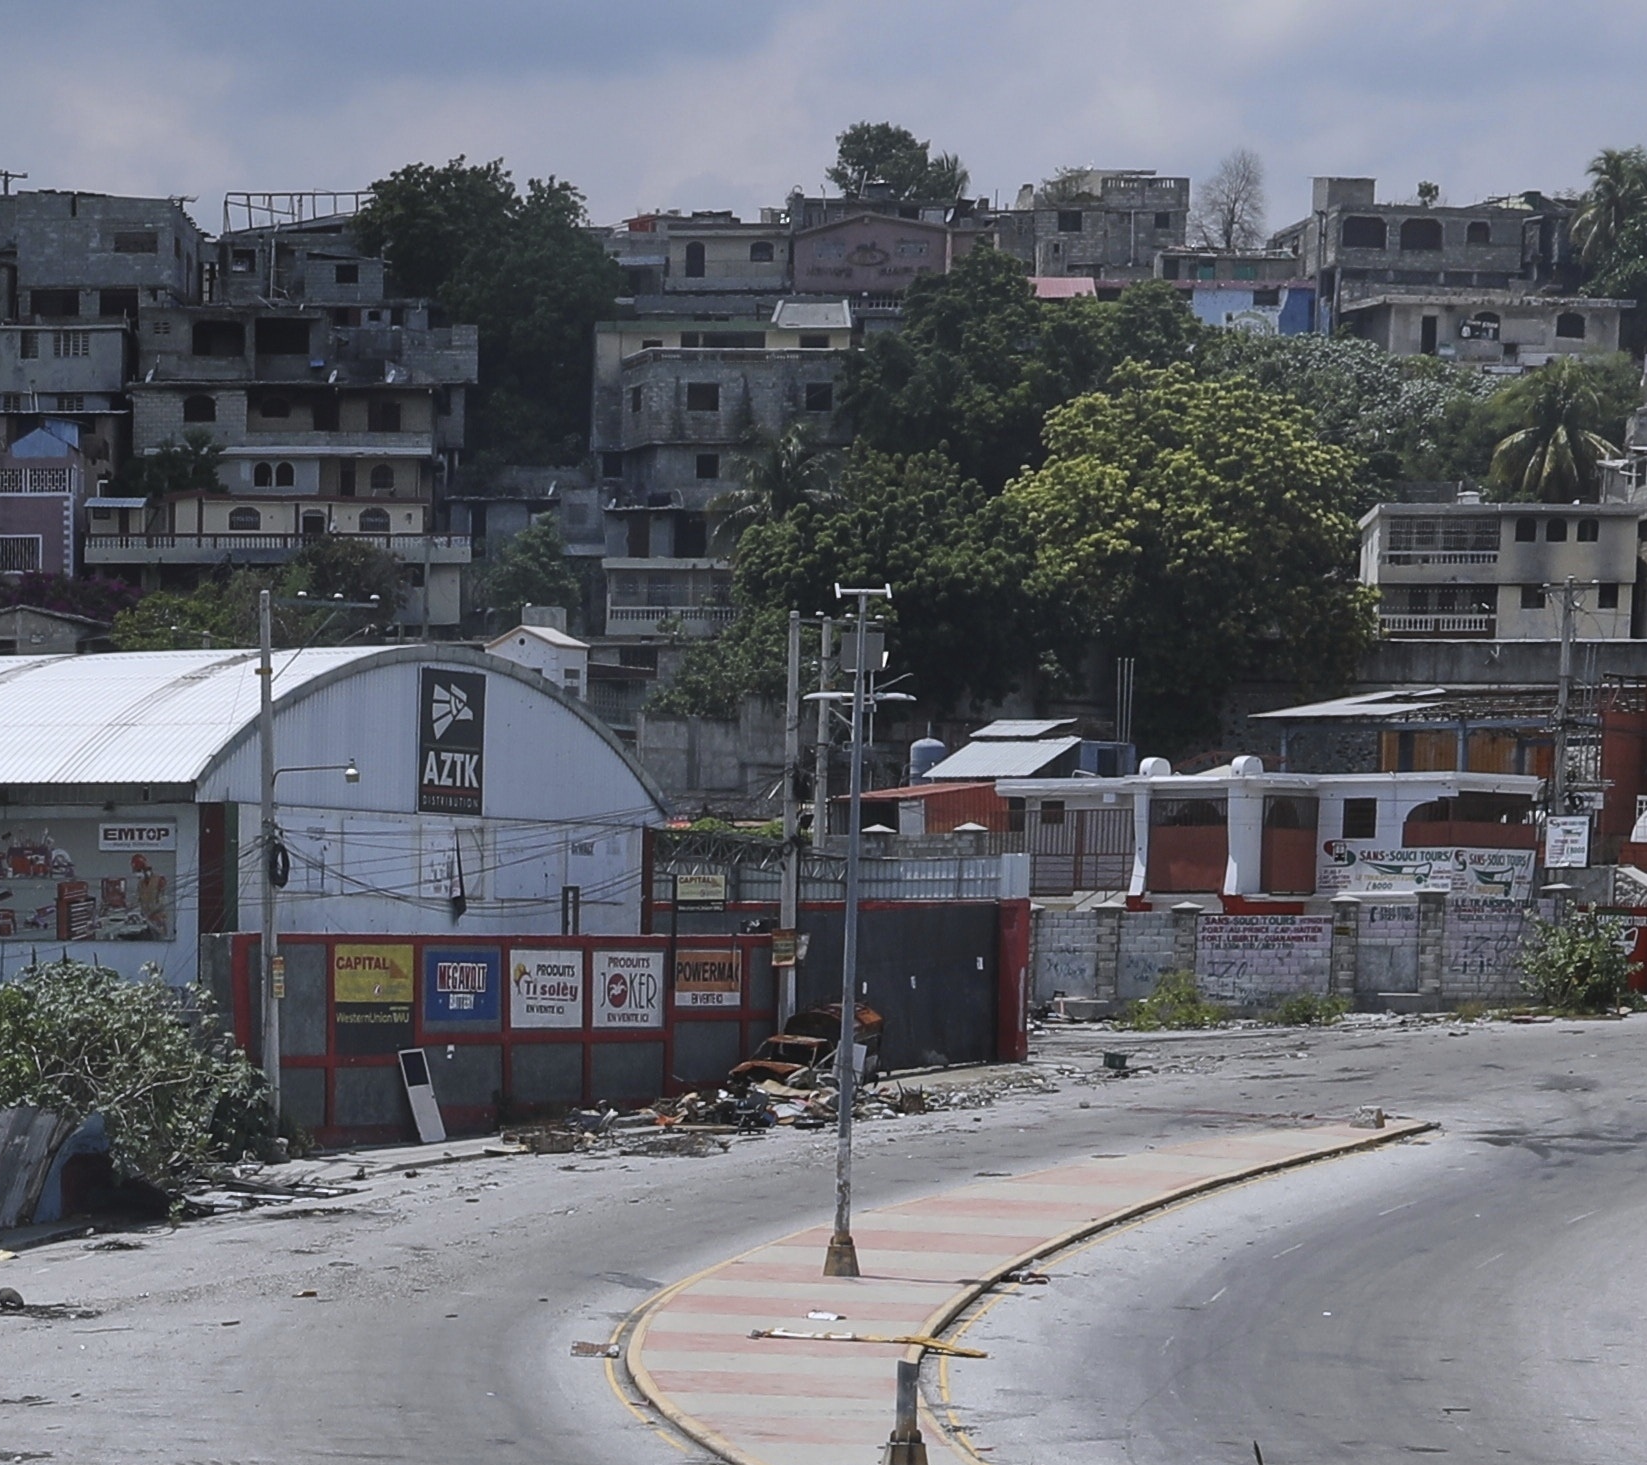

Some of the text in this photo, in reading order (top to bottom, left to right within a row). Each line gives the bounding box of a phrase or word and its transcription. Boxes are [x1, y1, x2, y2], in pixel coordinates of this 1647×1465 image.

[423, 751, 479, 788] AZTK
[423, 795, 479, 808] DISTRIBUTION
[103, 828, 170, 841] EMTOP
[1420, 851, 1448, 862] TOURS
[678, 876, 712, 885] CAPITAL
[336, 956, 390, 970] CAPITAL
[608, 956, 650, 969] PRODUITS
[437, 963, 488, 992] MEGAVOLT
[536, 964, 576, 978] PRODUITS
[600, 972, 657, 1009] JOKER
[526, 1005, 535, 1013] EN
[536, 1005, 556, 1014] VENTE
[607, 1012, 616, 1022] EN
[618, 1012, 640, 1022] VENTE
